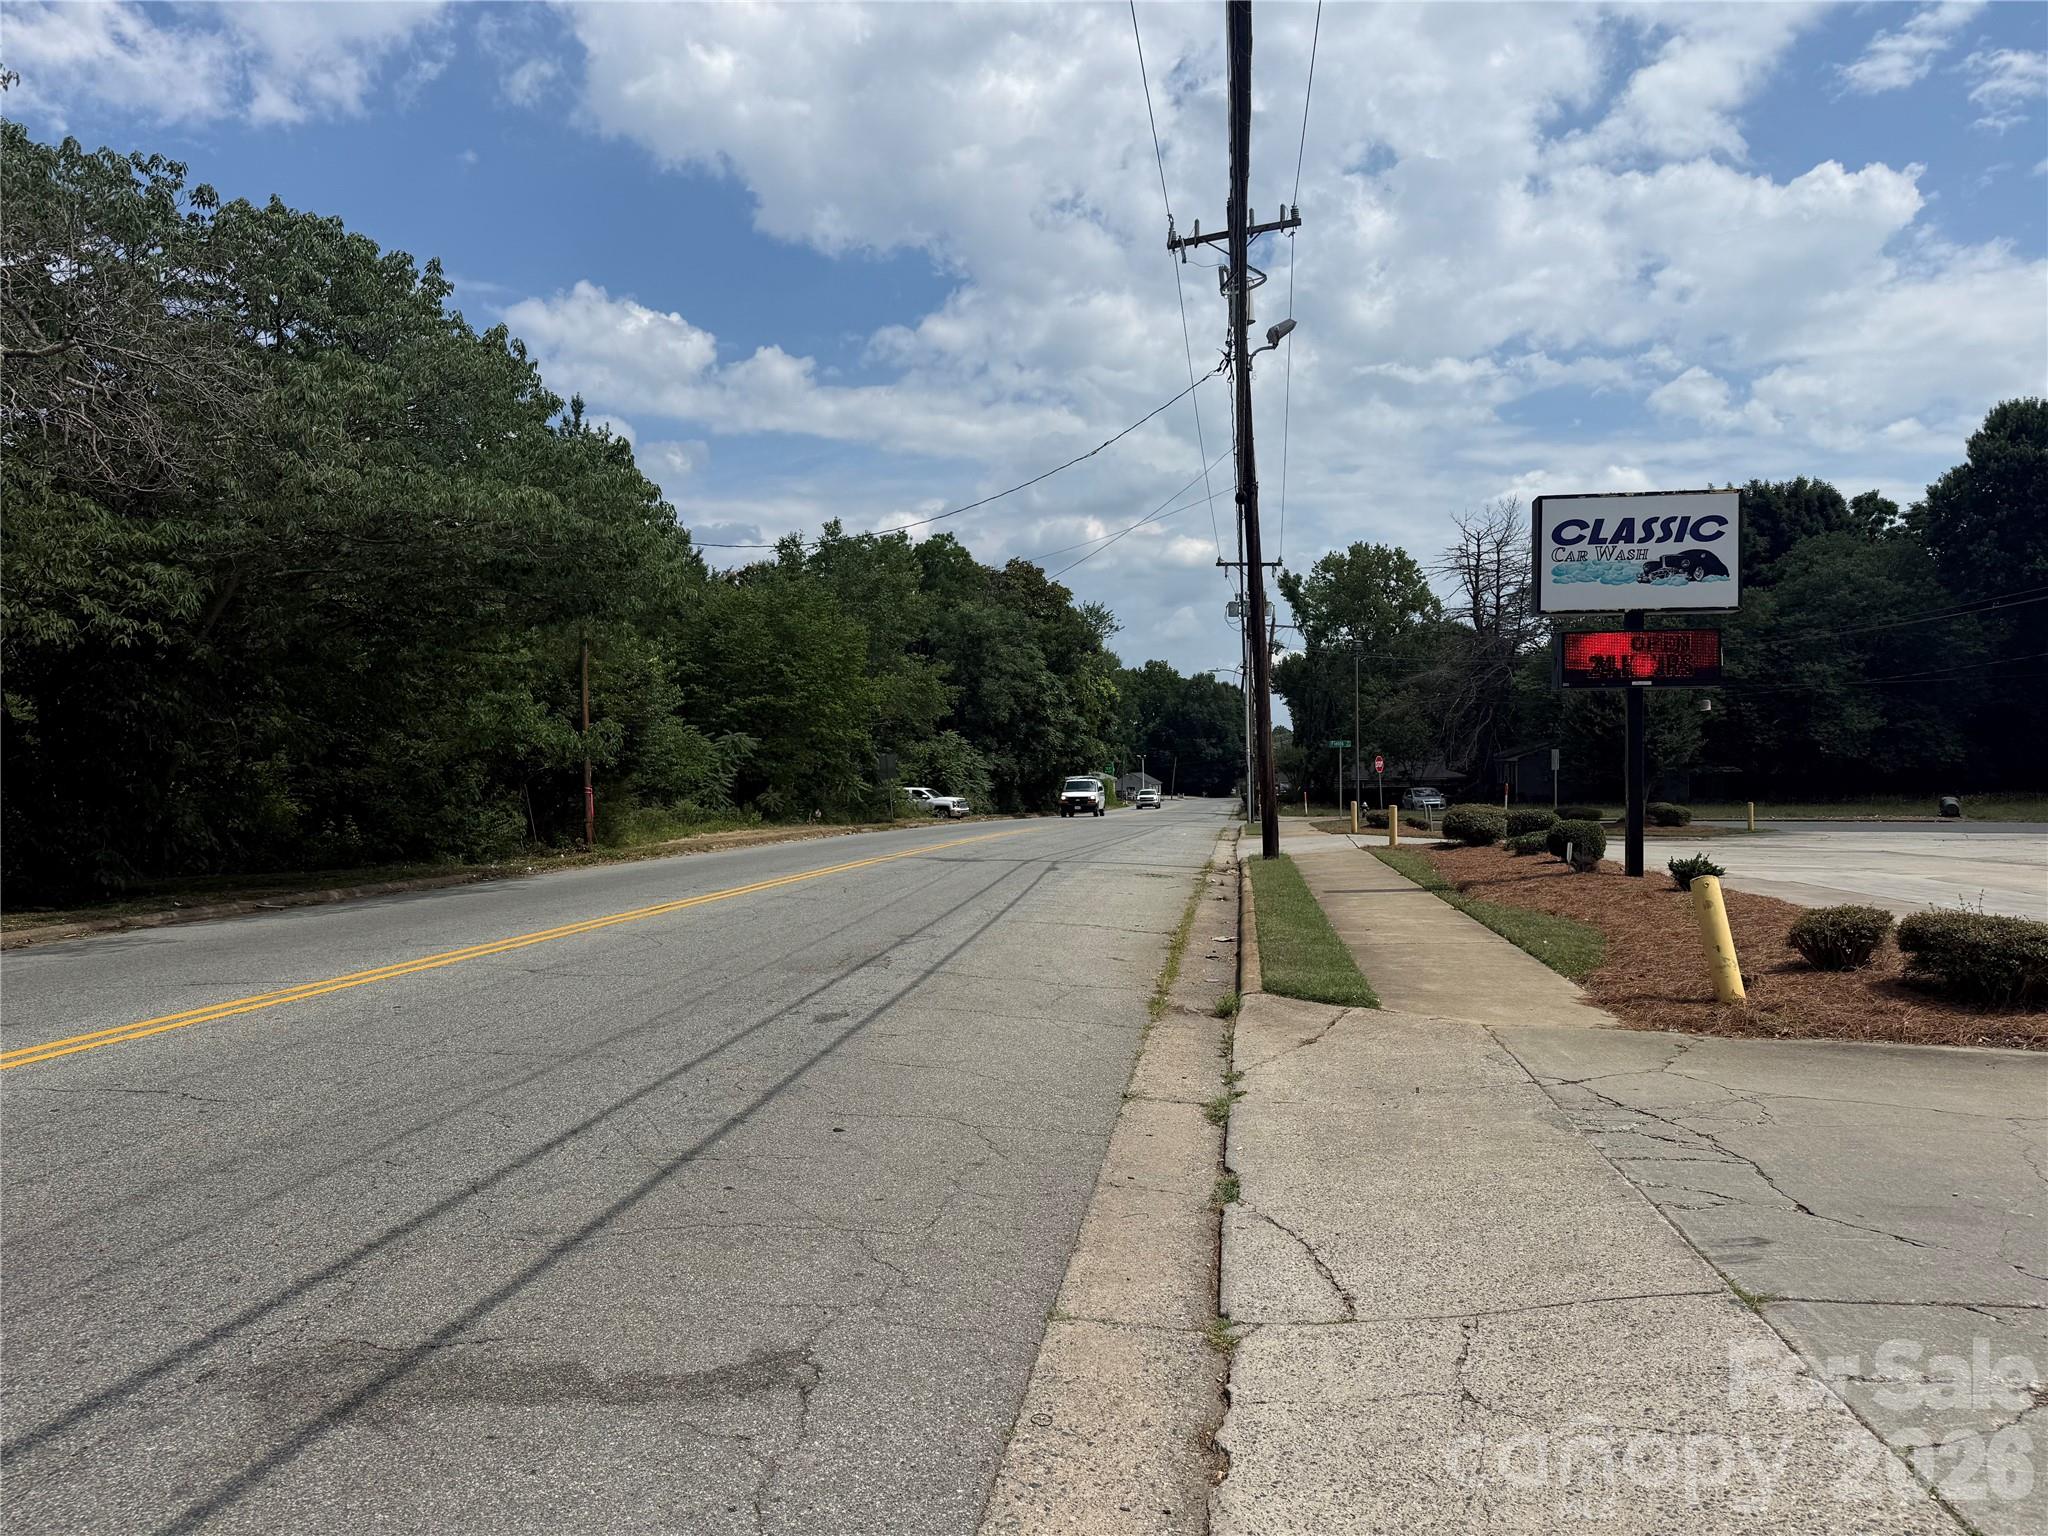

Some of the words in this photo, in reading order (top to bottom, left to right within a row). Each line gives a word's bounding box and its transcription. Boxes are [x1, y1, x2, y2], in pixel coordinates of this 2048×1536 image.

[1551, 515, 1729, 546] CLASSIC
[1631, 636, 1692, 651] OPEN
[1620, 655, 1695, 677] HURS
